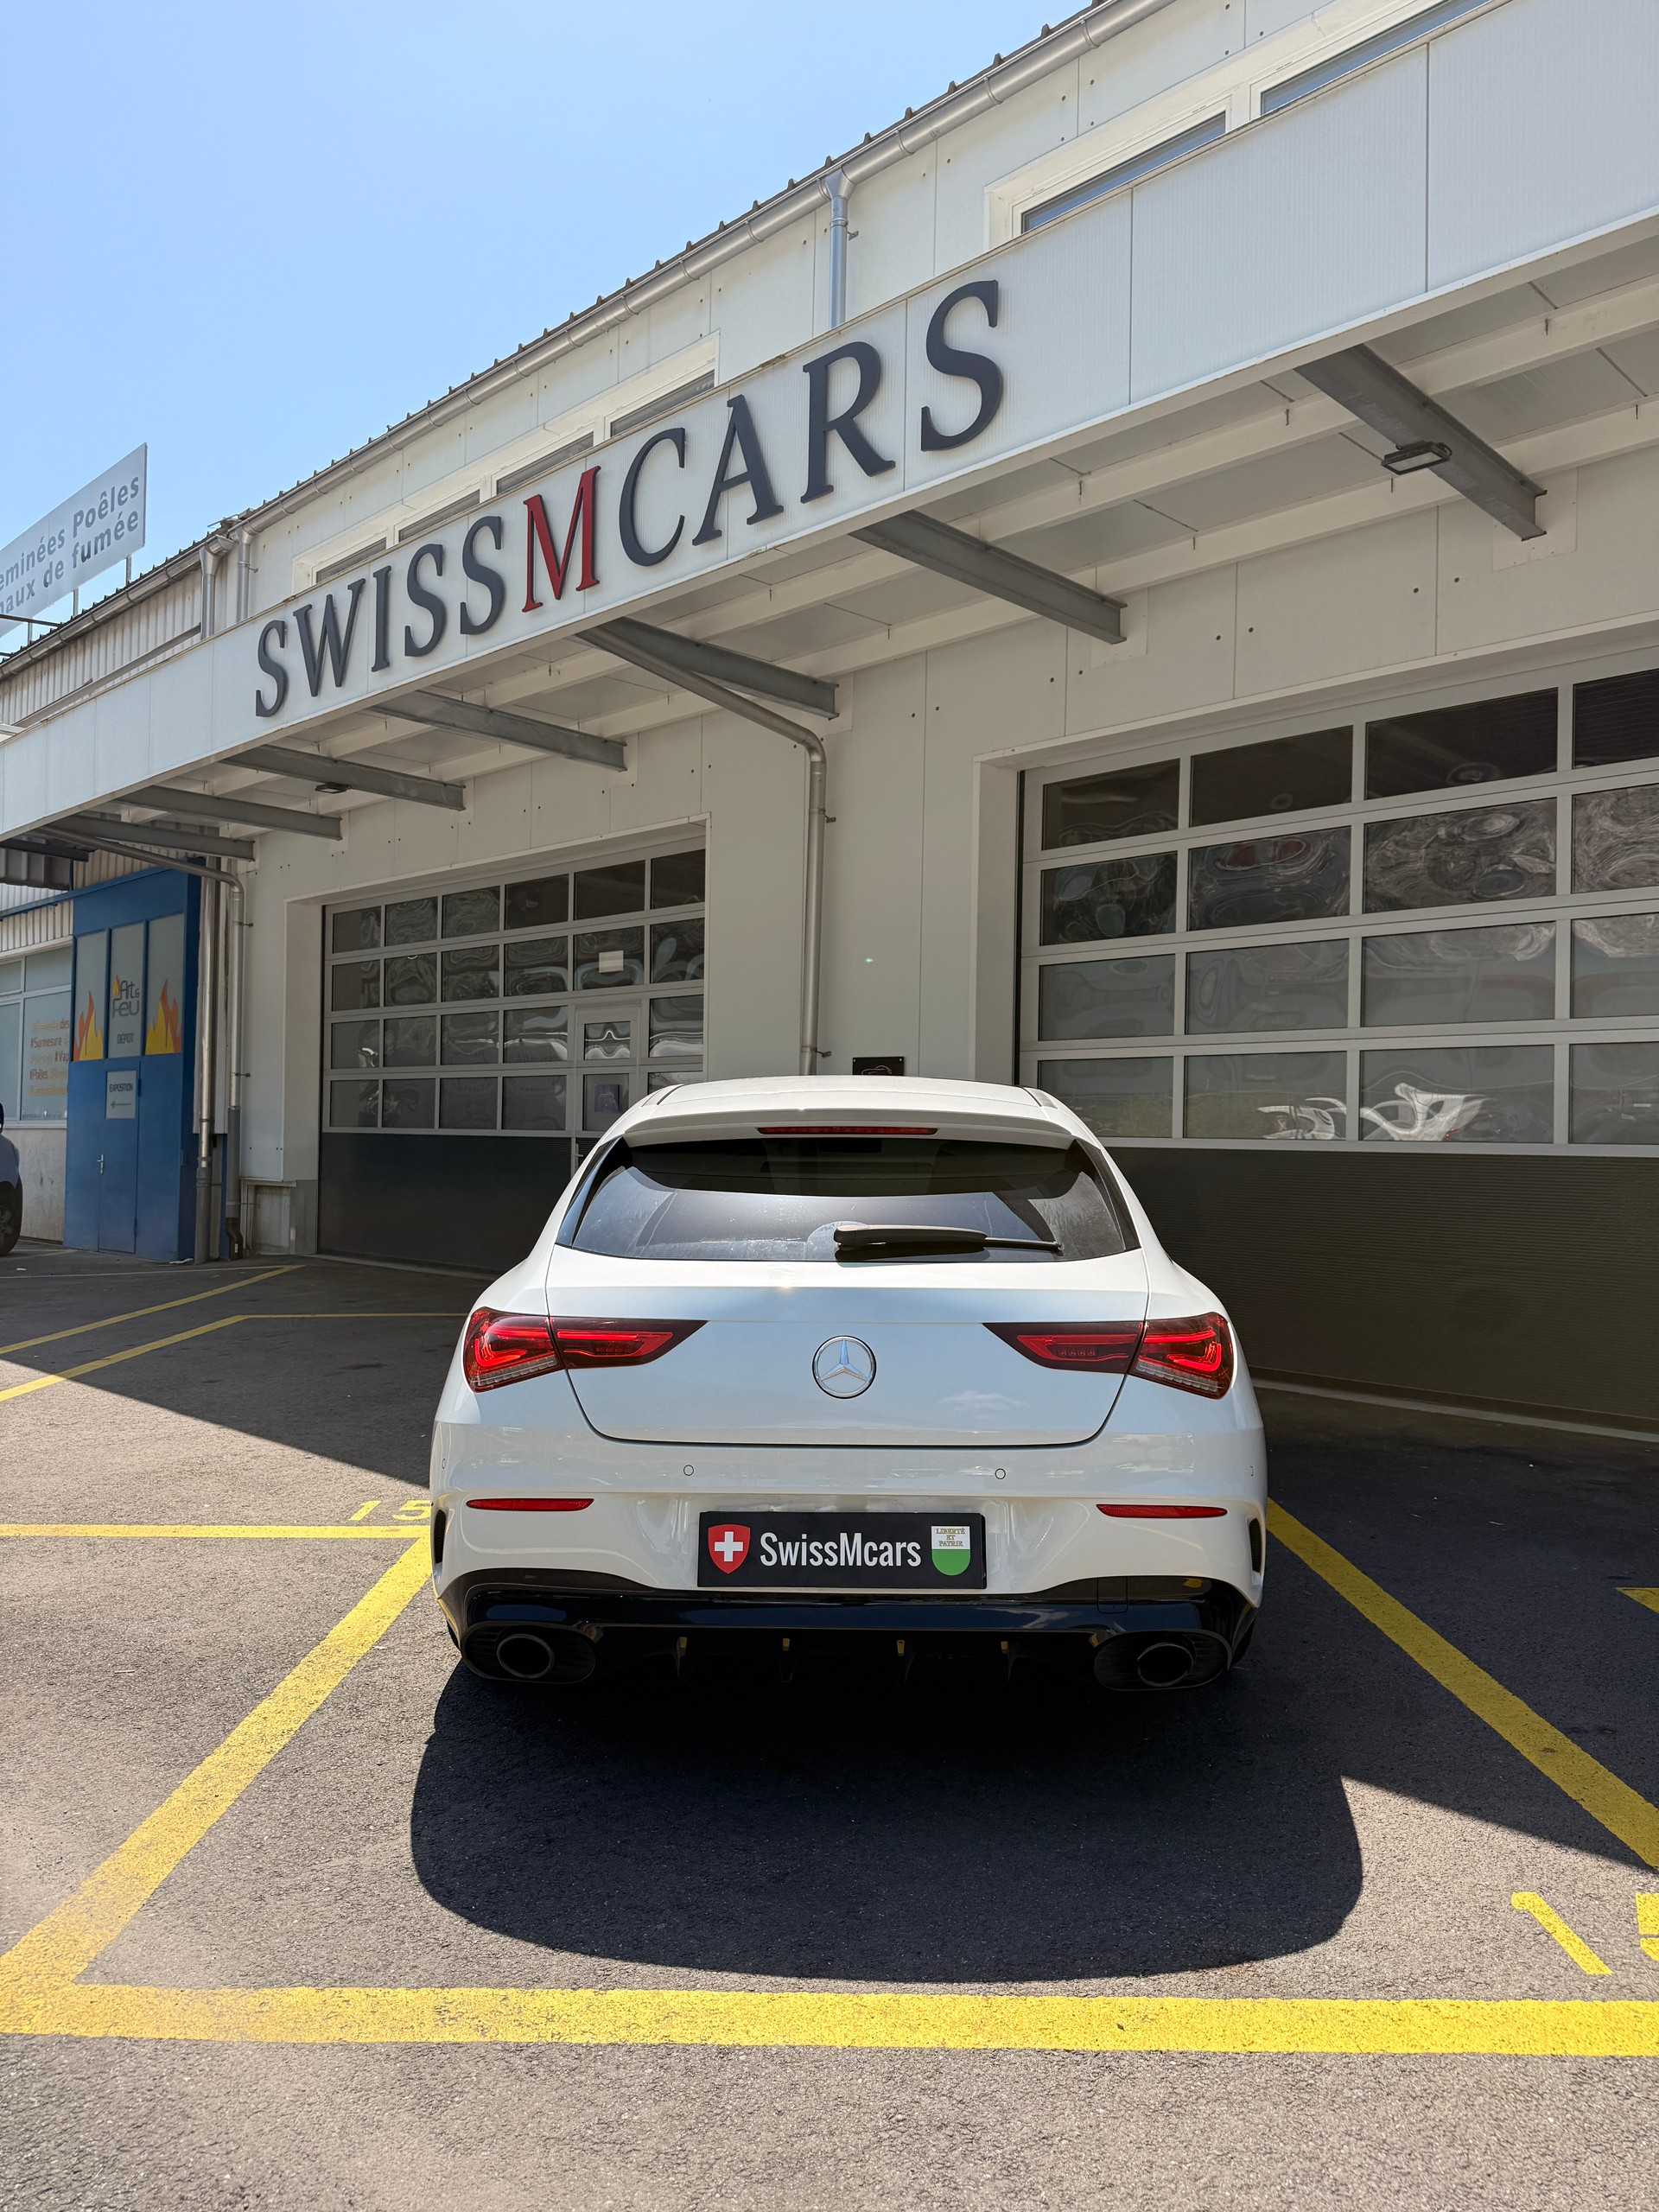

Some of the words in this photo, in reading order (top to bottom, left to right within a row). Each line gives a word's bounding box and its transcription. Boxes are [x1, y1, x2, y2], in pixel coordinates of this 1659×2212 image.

[73, 476, 139, 539] Poêles
[254, 279, 1005, 718] SWISSMCARS
[43, 561, 64, 588] de
[72, 511, 138, 569] fumée
[117, 1031, 135, 1045] DÉPOT
[109, 1083, 134, 1093] EXPOSITION
[760, 1532, 922, 1567] SwissMcars
